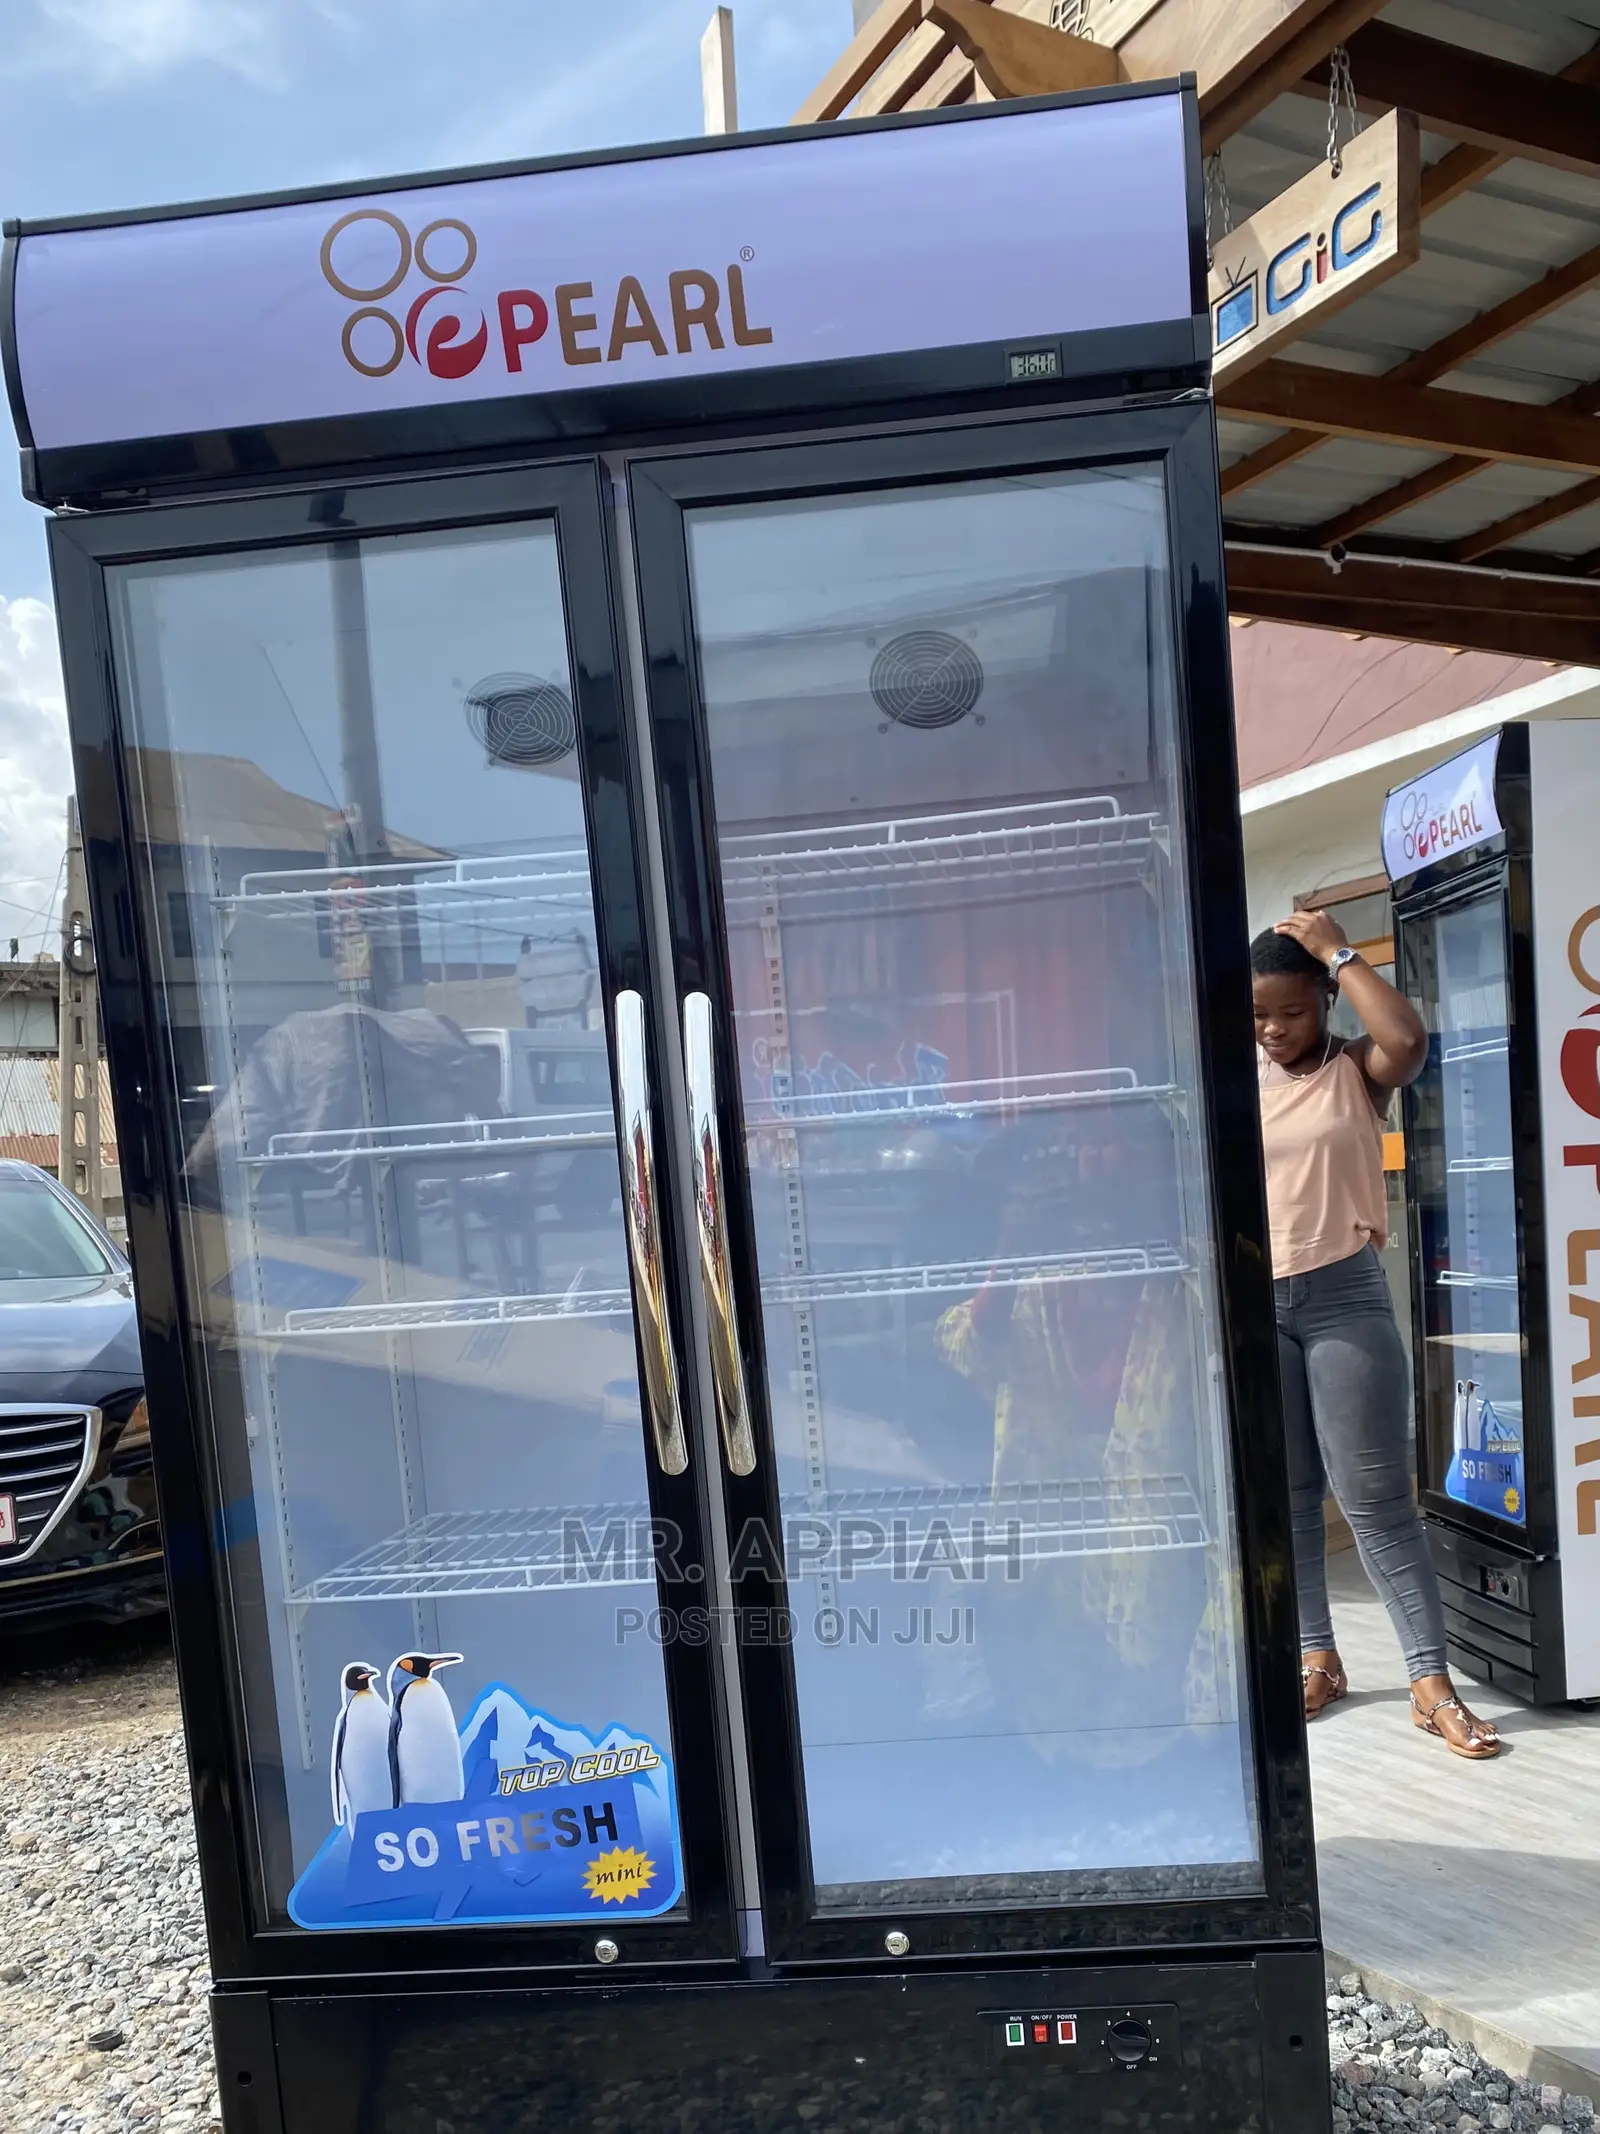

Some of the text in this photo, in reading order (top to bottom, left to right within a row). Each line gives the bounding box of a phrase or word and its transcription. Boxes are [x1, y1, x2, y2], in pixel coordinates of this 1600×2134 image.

[496, 263, 774, 373] PEARL
[1429, 799, 1484, 853] PEARL
[1461, 1459, 1476, 1479] SO
[500, 1744, 662, 1797] TOP COOL
[374, 1801, 620, 1873] SO FRESH
[594, 1861, 644, 1886] mini
